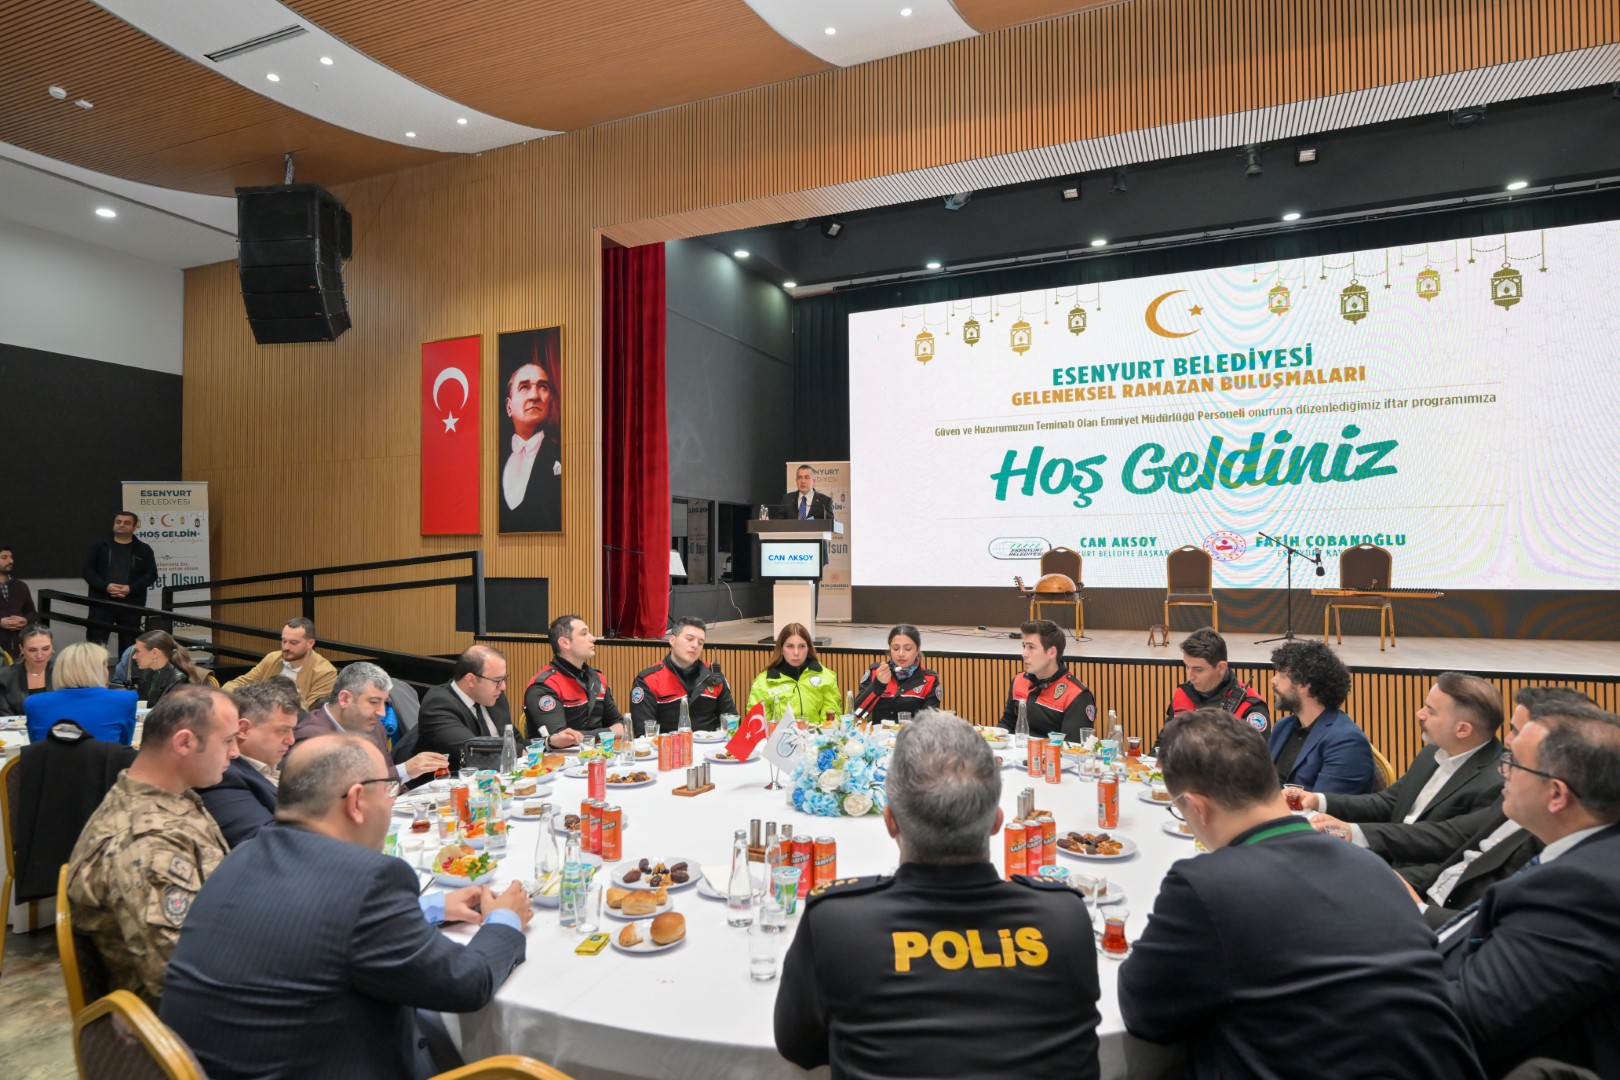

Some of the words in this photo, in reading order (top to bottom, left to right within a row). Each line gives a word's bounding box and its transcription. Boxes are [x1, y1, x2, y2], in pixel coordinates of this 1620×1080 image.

[1052, 359, 1165, 386] ESENYURT
[1174, 343, 1313, 377] BELEDİYESİ
[1012, 385, 1115, 407] GELENEKSEL
[1122, 377, 1214, 399] RAMAZAN
[1221, 365, 1366, 391] BULUŞMALARI
[935, 426, 961, 438] Güven
[963, 427, 972, 436] ve
[975, 423, 1034, 434] Huzurumuzun
[1036, 420, 1074, 431] Teminatı
[1077, 418, 1098, 428] Olan
[1100, 415, 1139, 427] Emniyet
[1141, 411, 1195, 424] Müdürlüğü
[1198, 407, 1245, 421] Personeli
[1248, 406, 1293, 418] onuruna
[1296, 399, 1381, 415] düzenlediğimiz
[1384, 397, 1407, 409] iftar
[1412, 393, 1497, 409] programımıza
[989, 445, 1107, 508] Hoş
[1121, 424, 1399, 495] Geldiniz
[140, 489, 192, 497] ESENYURT
[140, 498, 191, 506] BELEDİYESİ
[139, 531, 160, 539] HOŞ
[161, 529, 197, 538] GELDİN
[1255, 534, 1300, 547] FATİH
[1305, 532, 1407, 549] ÇOBANOĞLU
[1080, 537, 1106, 548] CAN
[1111, 536, 1158, 548] AKSOY
[1098, 549, 1135, 558] BELEDİYE
